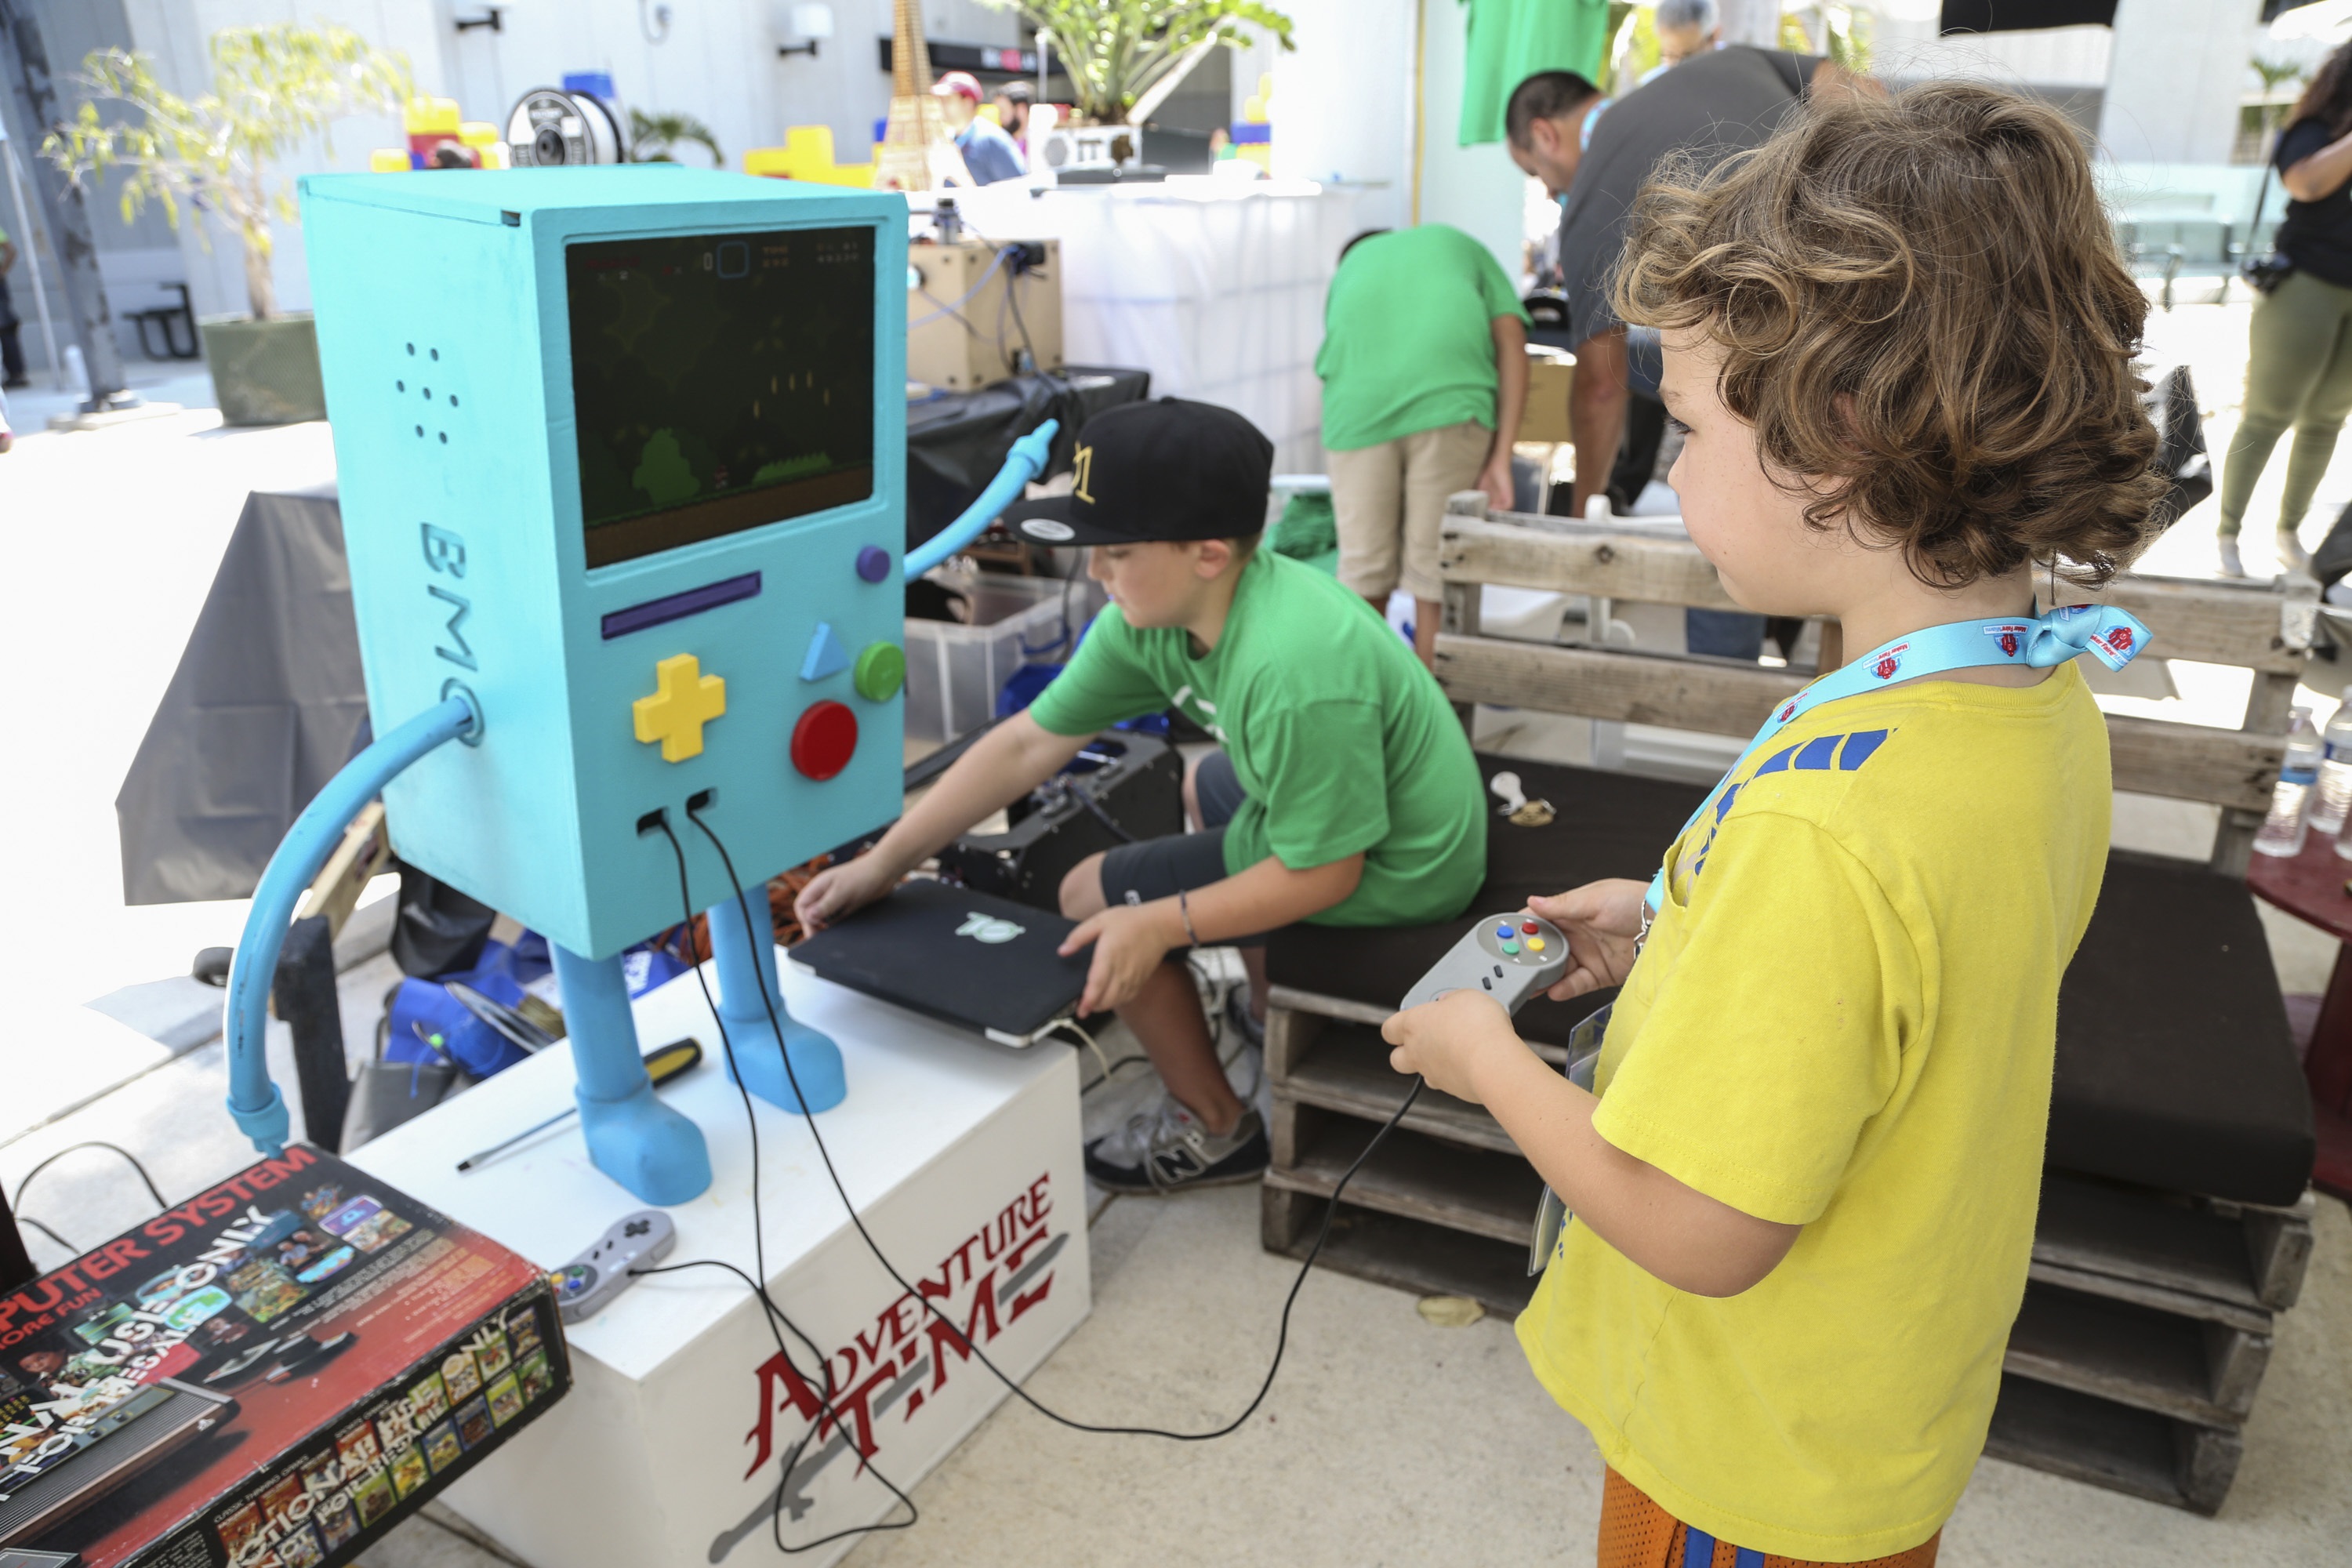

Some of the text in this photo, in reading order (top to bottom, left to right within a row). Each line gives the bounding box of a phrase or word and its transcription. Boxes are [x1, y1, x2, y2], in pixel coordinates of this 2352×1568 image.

[420, 521, 485, 748] BMO
[1890, 644, 1908, 654] Maker
[2100, 642, 2117, 657] Faire
[143, 1145, 318, 1247] SYSTEM
[0, 1287, 103, 1350] ORE FUN
[84, 1298, 177, 1366] USE
[175, 1204, 275, 1290] ONLY
[440, 1305, 510, 1381] ONLY
[743, 1171, 1054, 1482] ADVENTURE
[818, 1224, 1056, 1481] TIME
[14, 1414, 98, 1475] FOR
[245, 1473, 281, 1501] THINKING
[281, 1454, 310, 1476] GAMES
